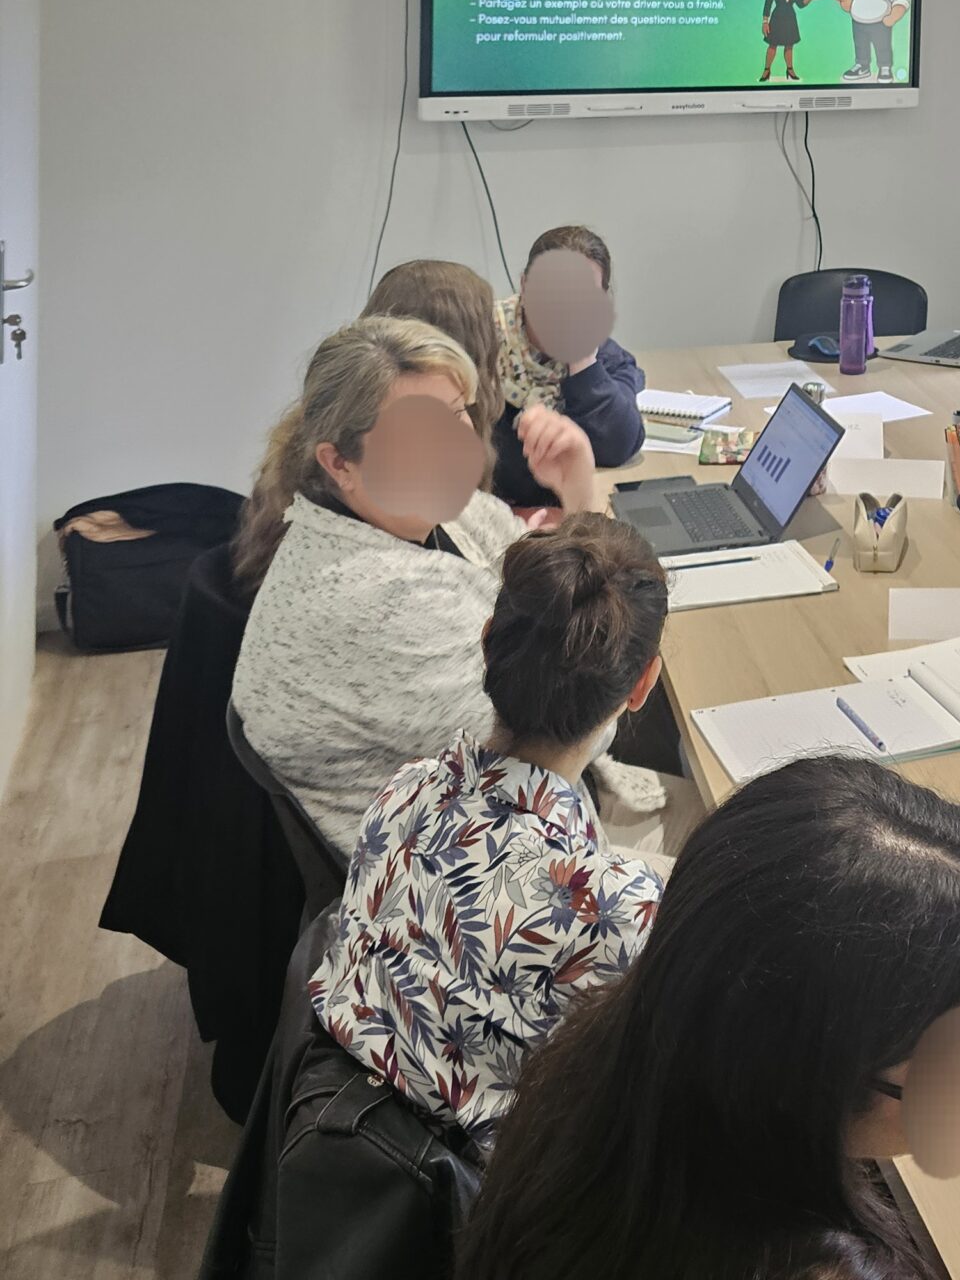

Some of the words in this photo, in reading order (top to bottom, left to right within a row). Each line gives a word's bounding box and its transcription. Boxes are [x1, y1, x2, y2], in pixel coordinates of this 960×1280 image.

[529, 0, 542, 9] un
[605, 0, 631, 10] votre
[662, 0, 685, 10] vous
[686, 1, 694, 10] a
[478, 13, 538, 25] Posez-vous
[539, 13, 608, 25] mutuellement
[609, 13, 628, 25] des
[630, 14, 677, 27] questions
[678, 15, 719, 25] ouvertes
[476, 31, 502, 45] pour
[503, 29, 557, 42] reformuler
